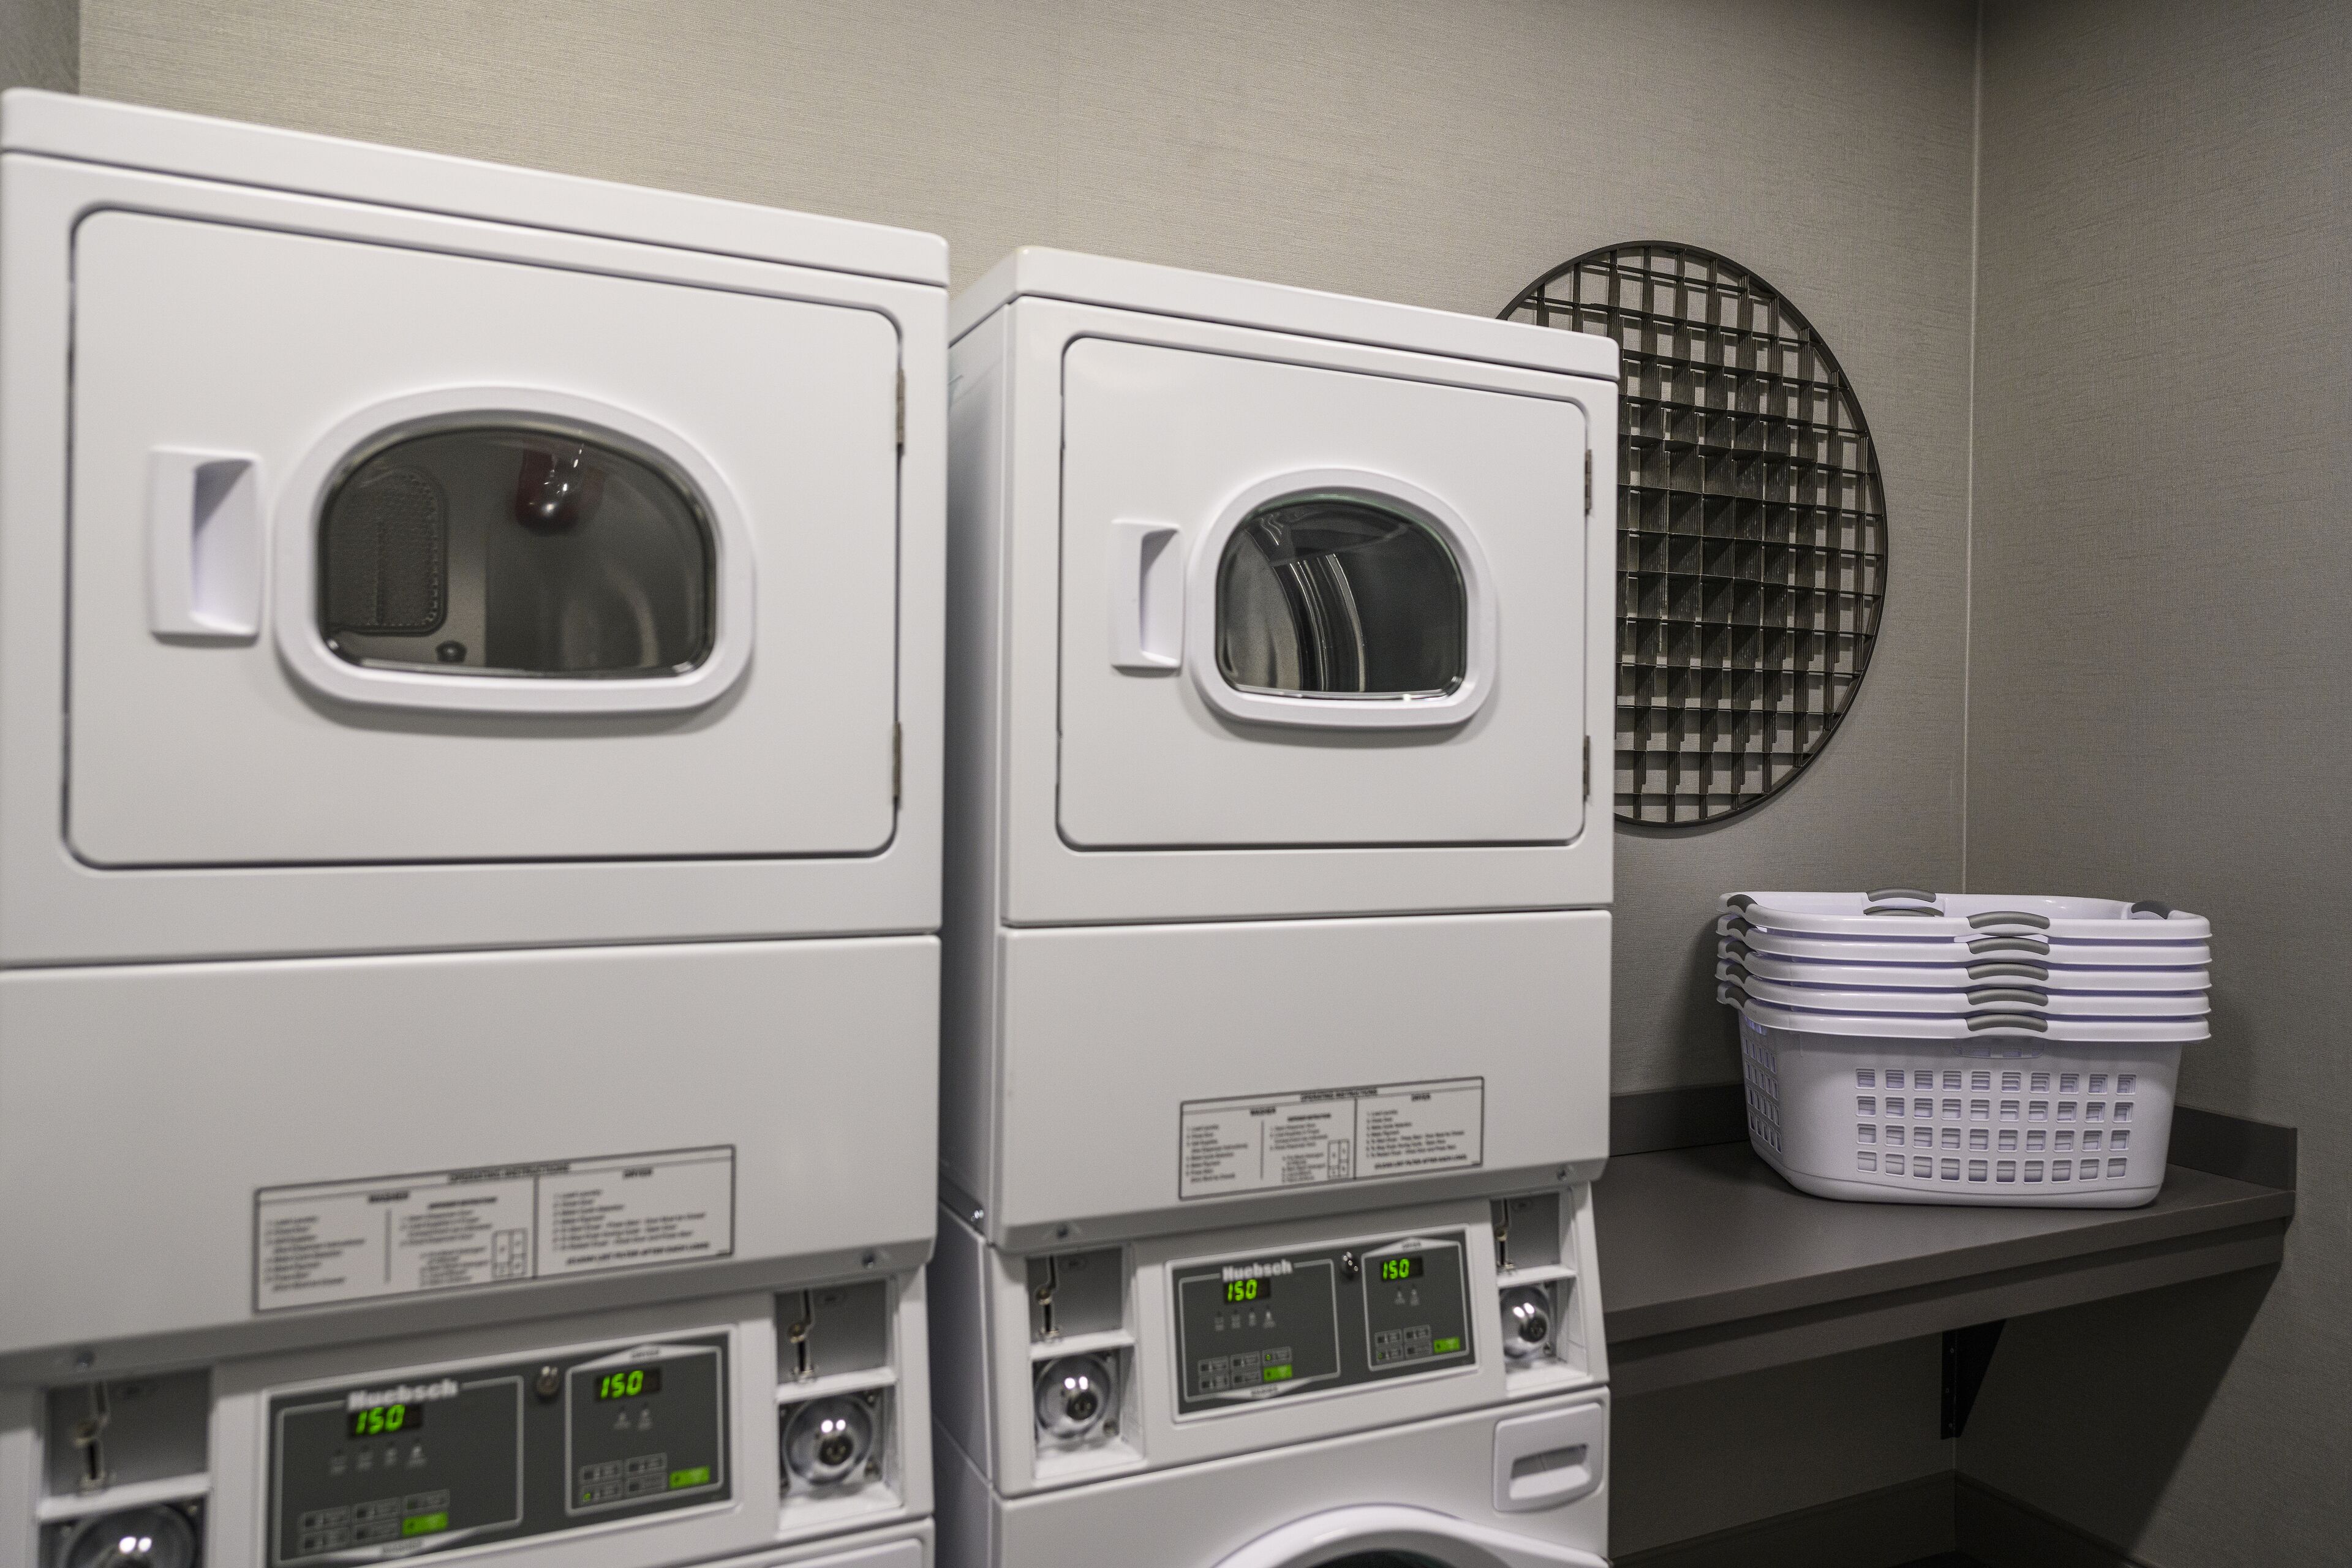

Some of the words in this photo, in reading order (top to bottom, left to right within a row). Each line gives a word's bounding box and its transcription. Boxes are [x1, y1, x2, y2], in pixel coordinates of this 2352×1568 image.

[1223, 1259, 1292, 1282] Huebsch
[1382, 1258, 1410, 1280] 150
[1227, 1279, 1257, 1302] 150
[600, 1370, 644, 1399] 150
[355, 1404, 405, 1435] 150
